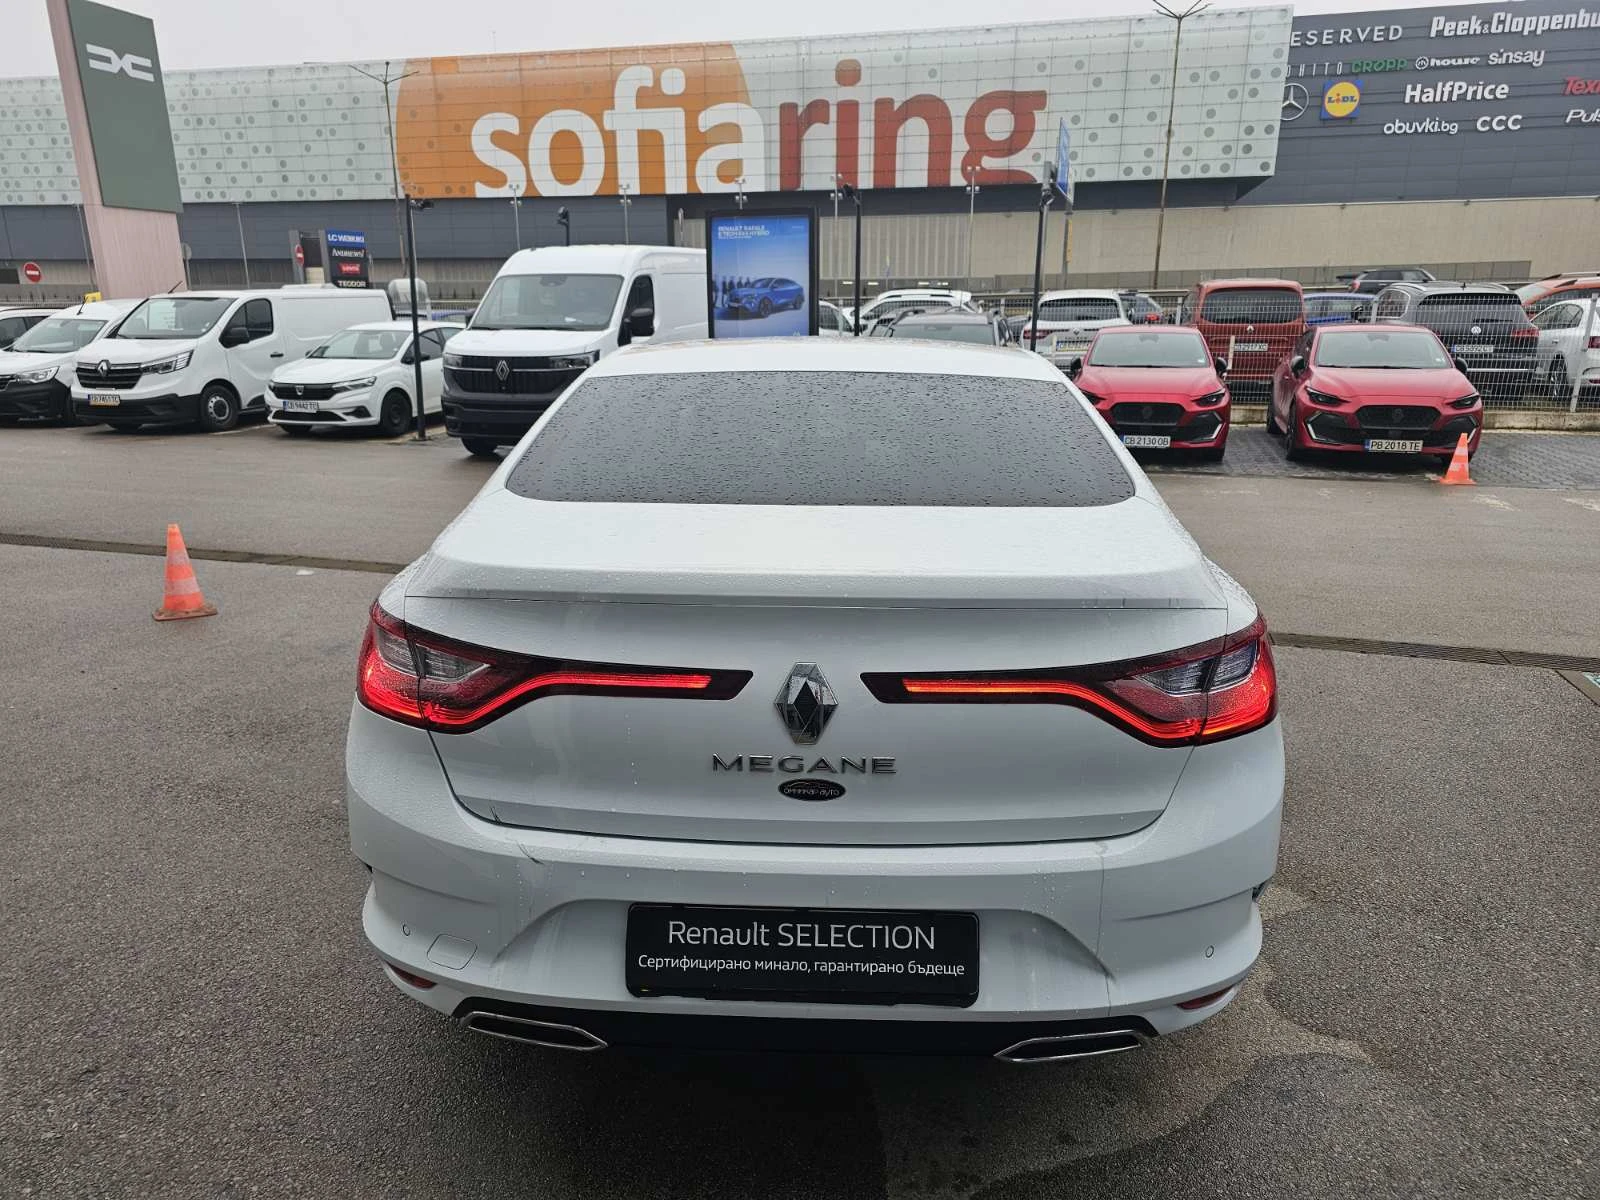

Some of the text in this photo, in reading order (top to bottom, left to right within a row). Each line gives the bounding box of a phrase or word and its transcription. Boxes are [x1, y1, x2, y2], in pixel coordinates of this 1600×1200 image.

[1488, 49, 1545, 67] sinsay
[1404, 81, 1510, 104] HalfPrice
[1383, 117, 1459, 135] obuvki.bg
[1476, 114, 1523, 132] CCC
[1385, 441, 1406, 449] 2018
[1410, 442, 1420, 450] TE
[712, 752, 898, 774] MEGANE
[668, 921, 935, 950] Renault SELECTION
[638, 955, 965, 977] Сертифицирано минало, гарантирано бъдеще
